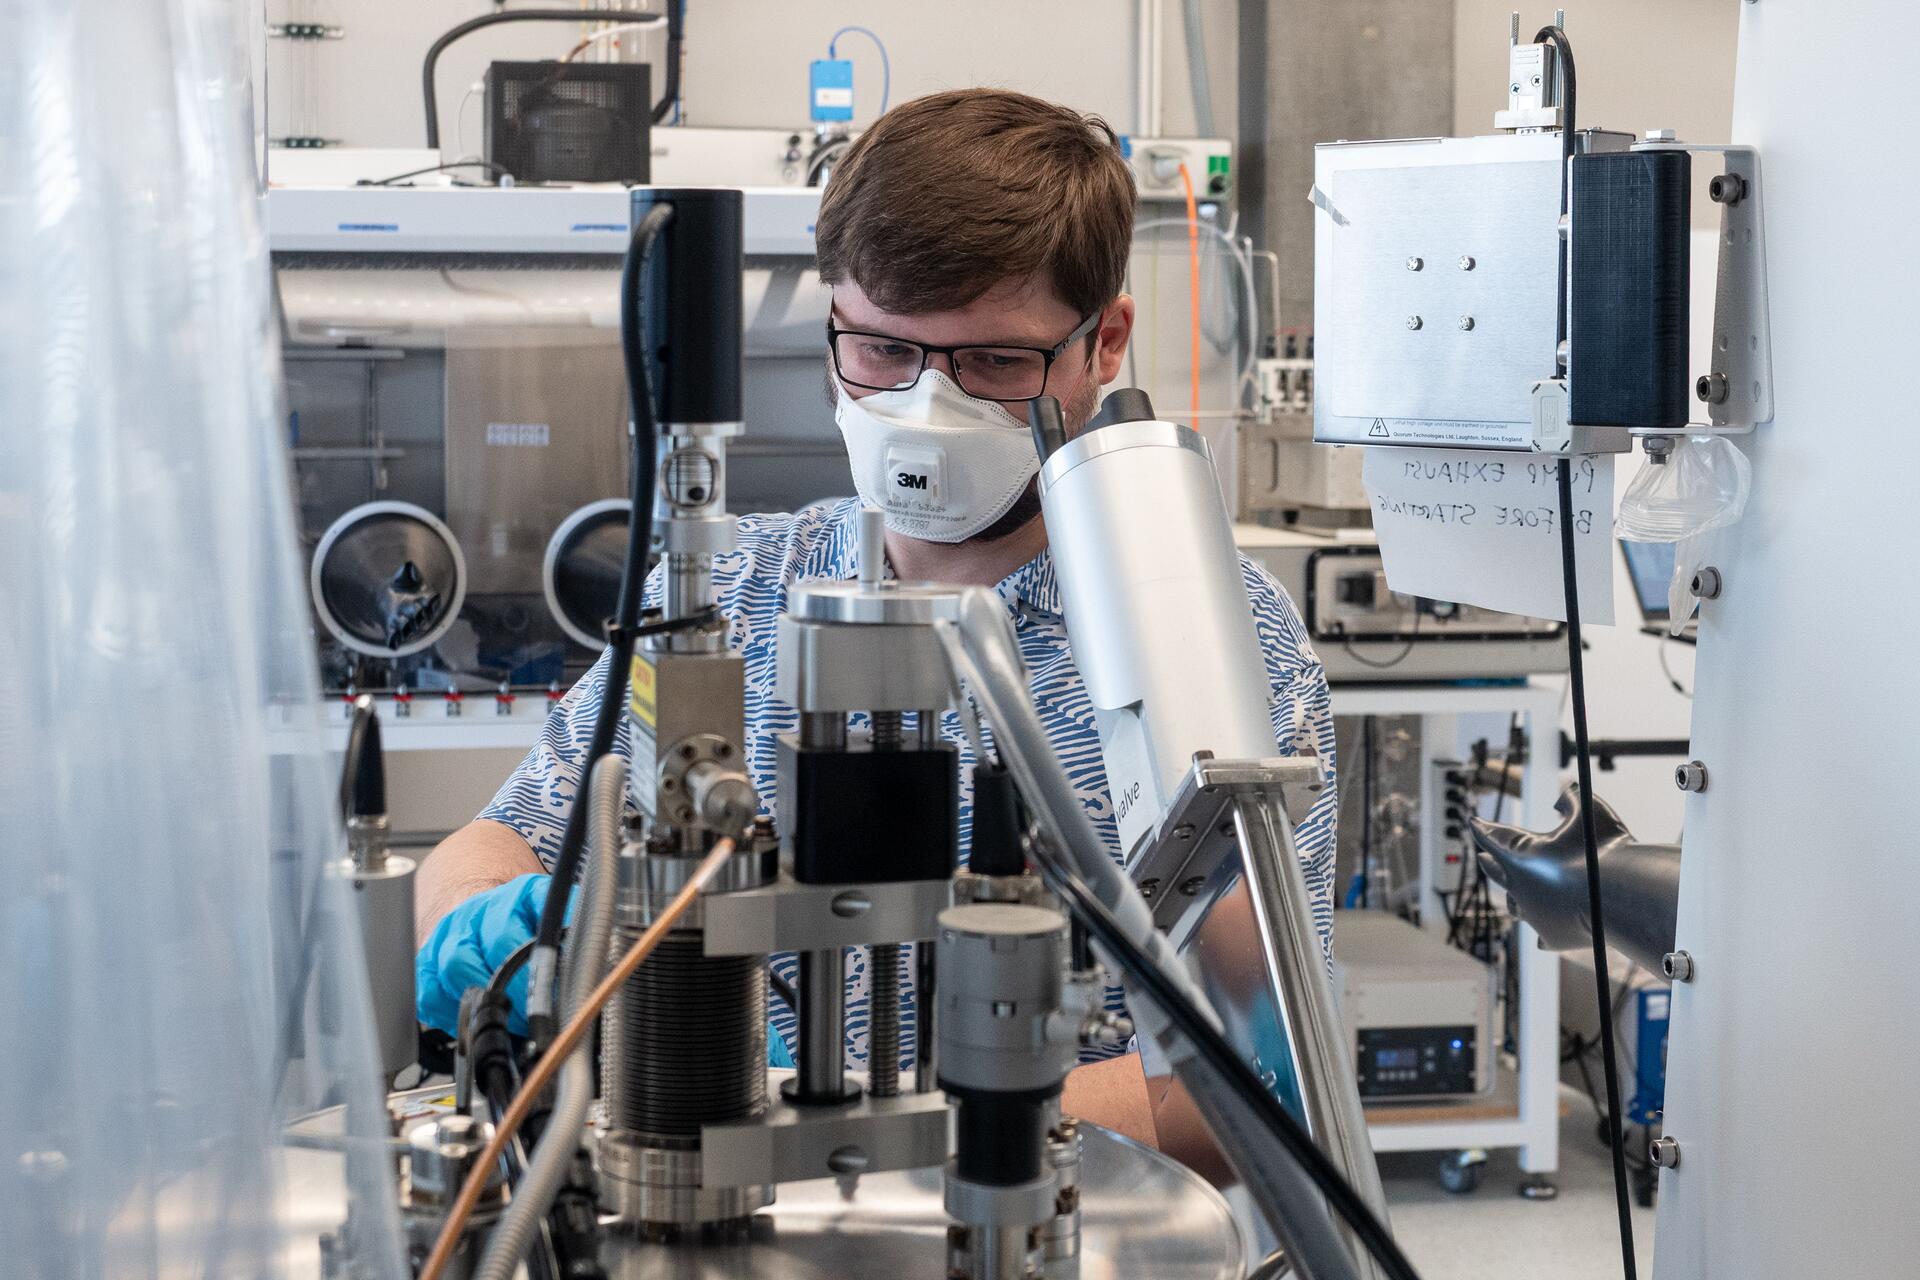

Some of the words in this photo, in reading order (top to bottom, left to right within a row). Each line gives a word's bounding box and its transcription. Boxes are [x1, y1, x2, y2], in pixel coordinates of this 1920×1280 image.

[1413, 432, 1445, 440] Technologies
[897, 472, 928, 490] 3M
[1116, 781, 1140, 823] valve
